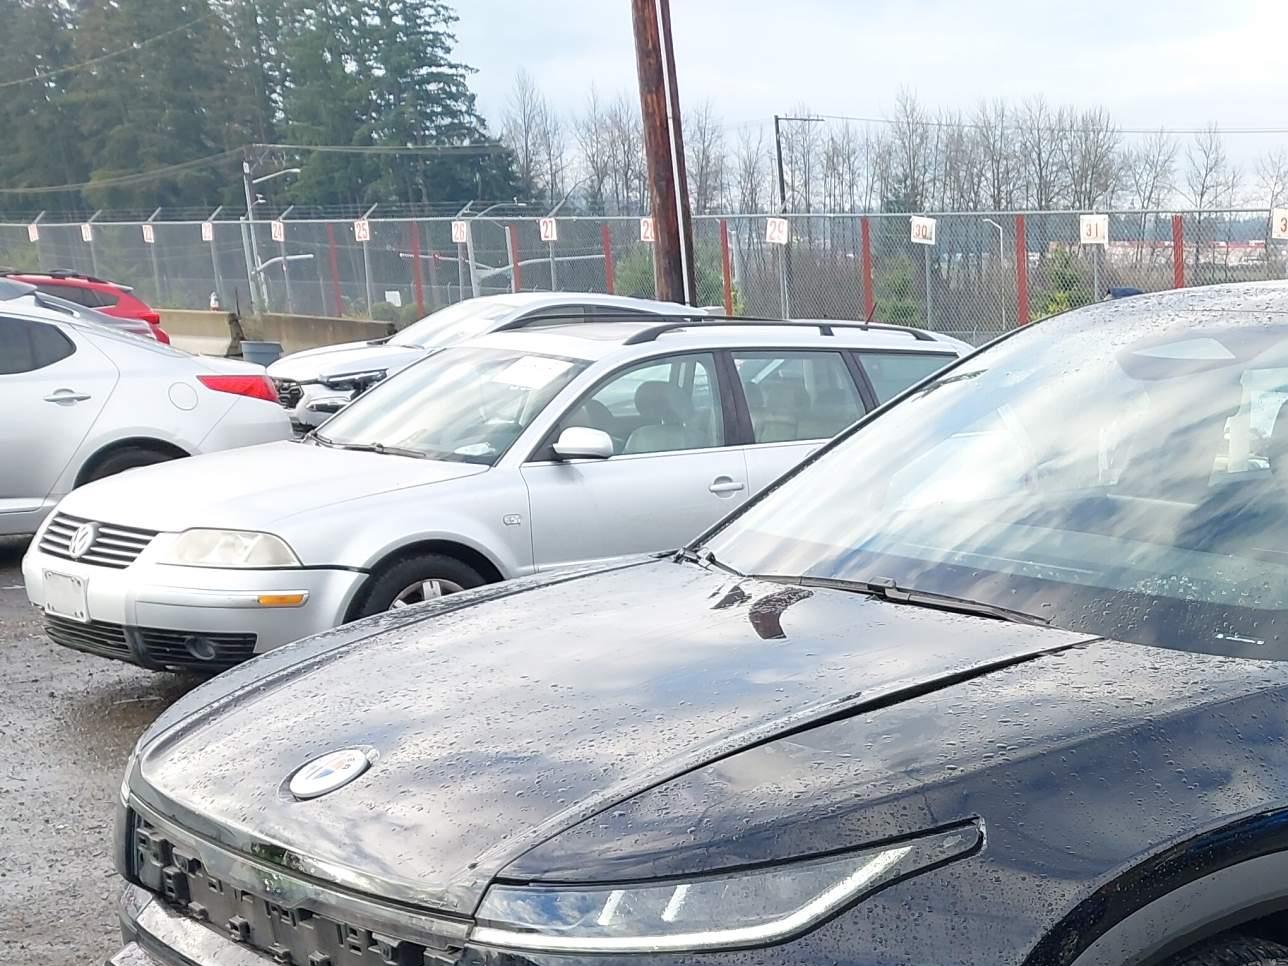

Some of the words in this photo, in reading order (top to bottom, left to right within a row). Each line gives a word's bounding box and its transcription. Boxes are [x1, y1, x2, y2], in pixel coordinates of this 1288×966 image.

[273, 222, 282, 239] 24
[356, 221, 367, 239] 25
[454, 221, 465, 239] 26
[543, 219, 554, 239] 27
[769, 220, 784, 240] 29
[912, 224, 927, 240] 30
[1085, 223, 1099, 237] 31
